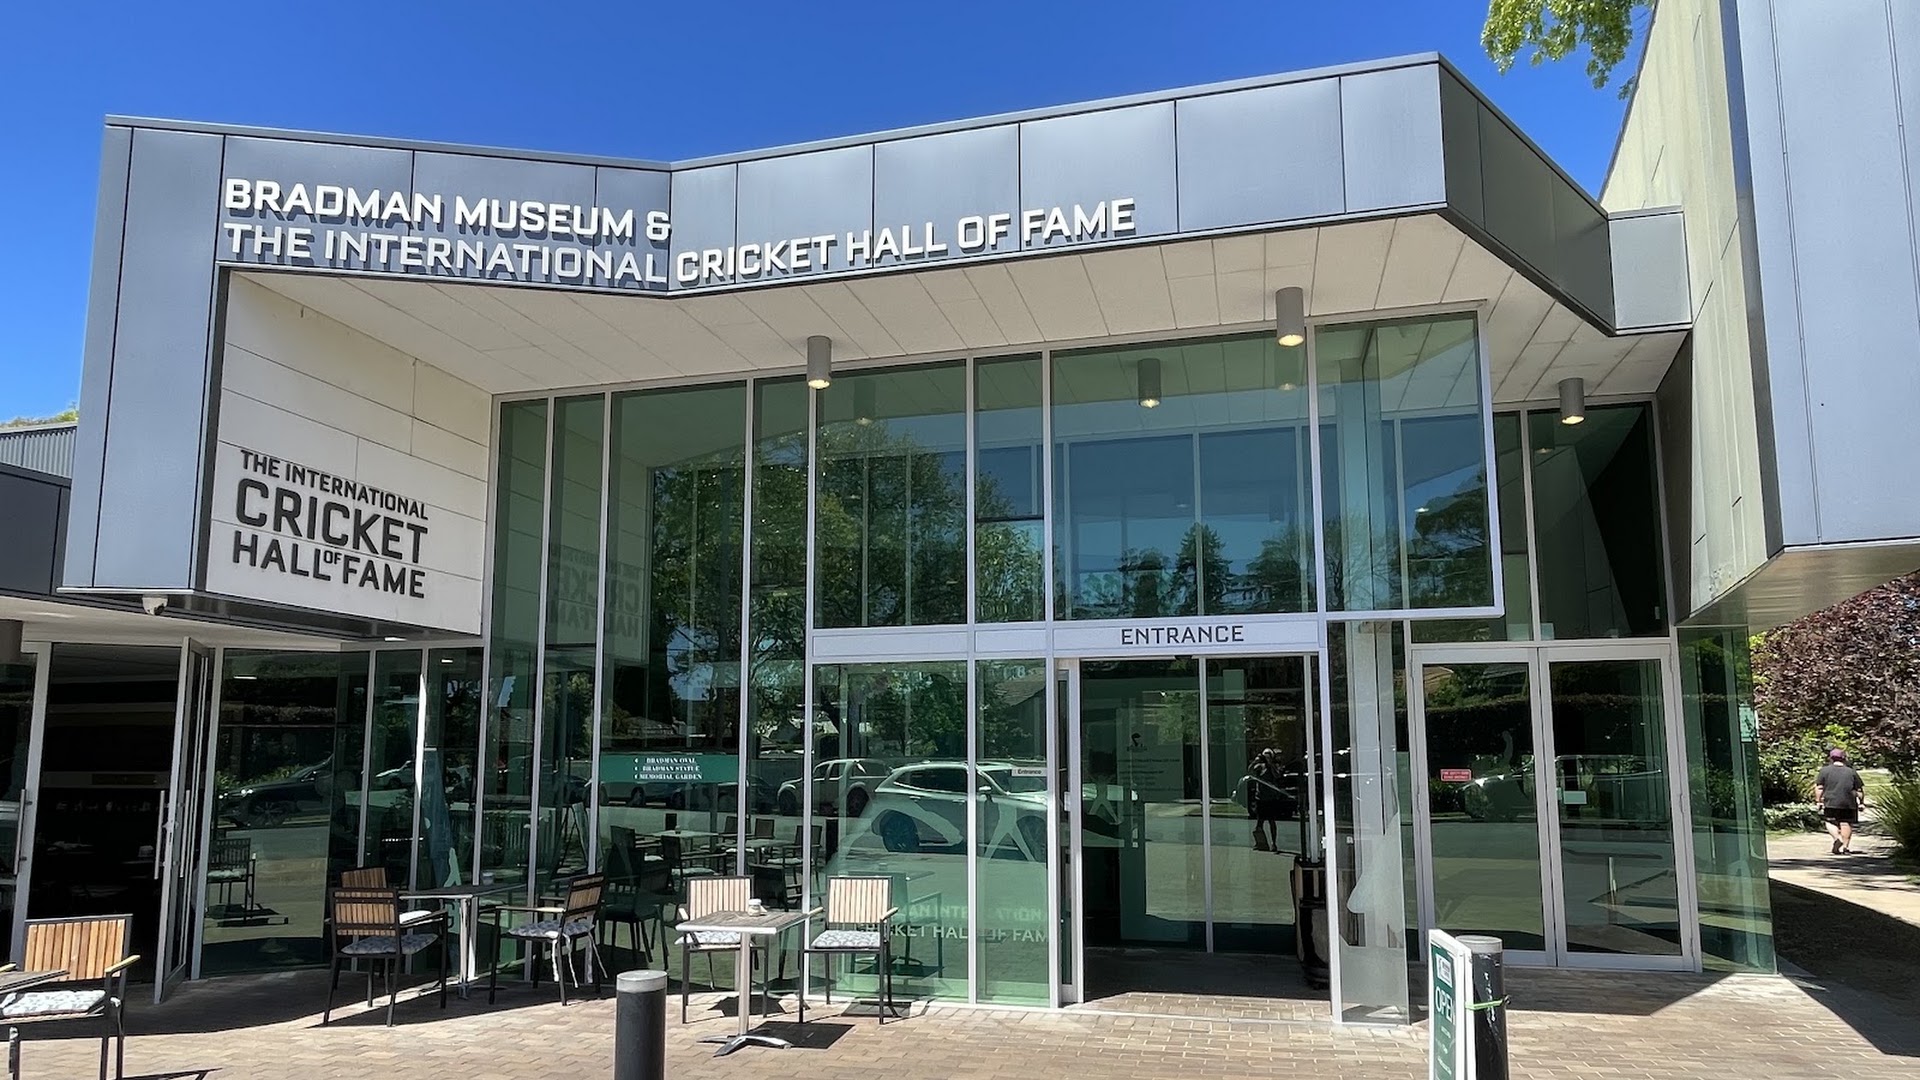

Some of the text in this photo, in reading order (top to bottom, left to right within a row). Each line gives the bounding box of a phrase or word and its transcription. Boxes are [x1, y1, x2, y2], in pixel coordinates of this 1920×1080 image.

[224, 178, 671, 240] BRADMAN MUSEUM &
[224, 198, 1136, 283] THE INTERNATIONAL CRICKET HALL OF FAME
[240, 449, 428, 520] THE INTERNATIONAL
[236, 478, 428, 564] CRICKET
[232, 530, 426, 599] HALL OF FAME
[1120, 625, 1245, 645] ENTRANCE
